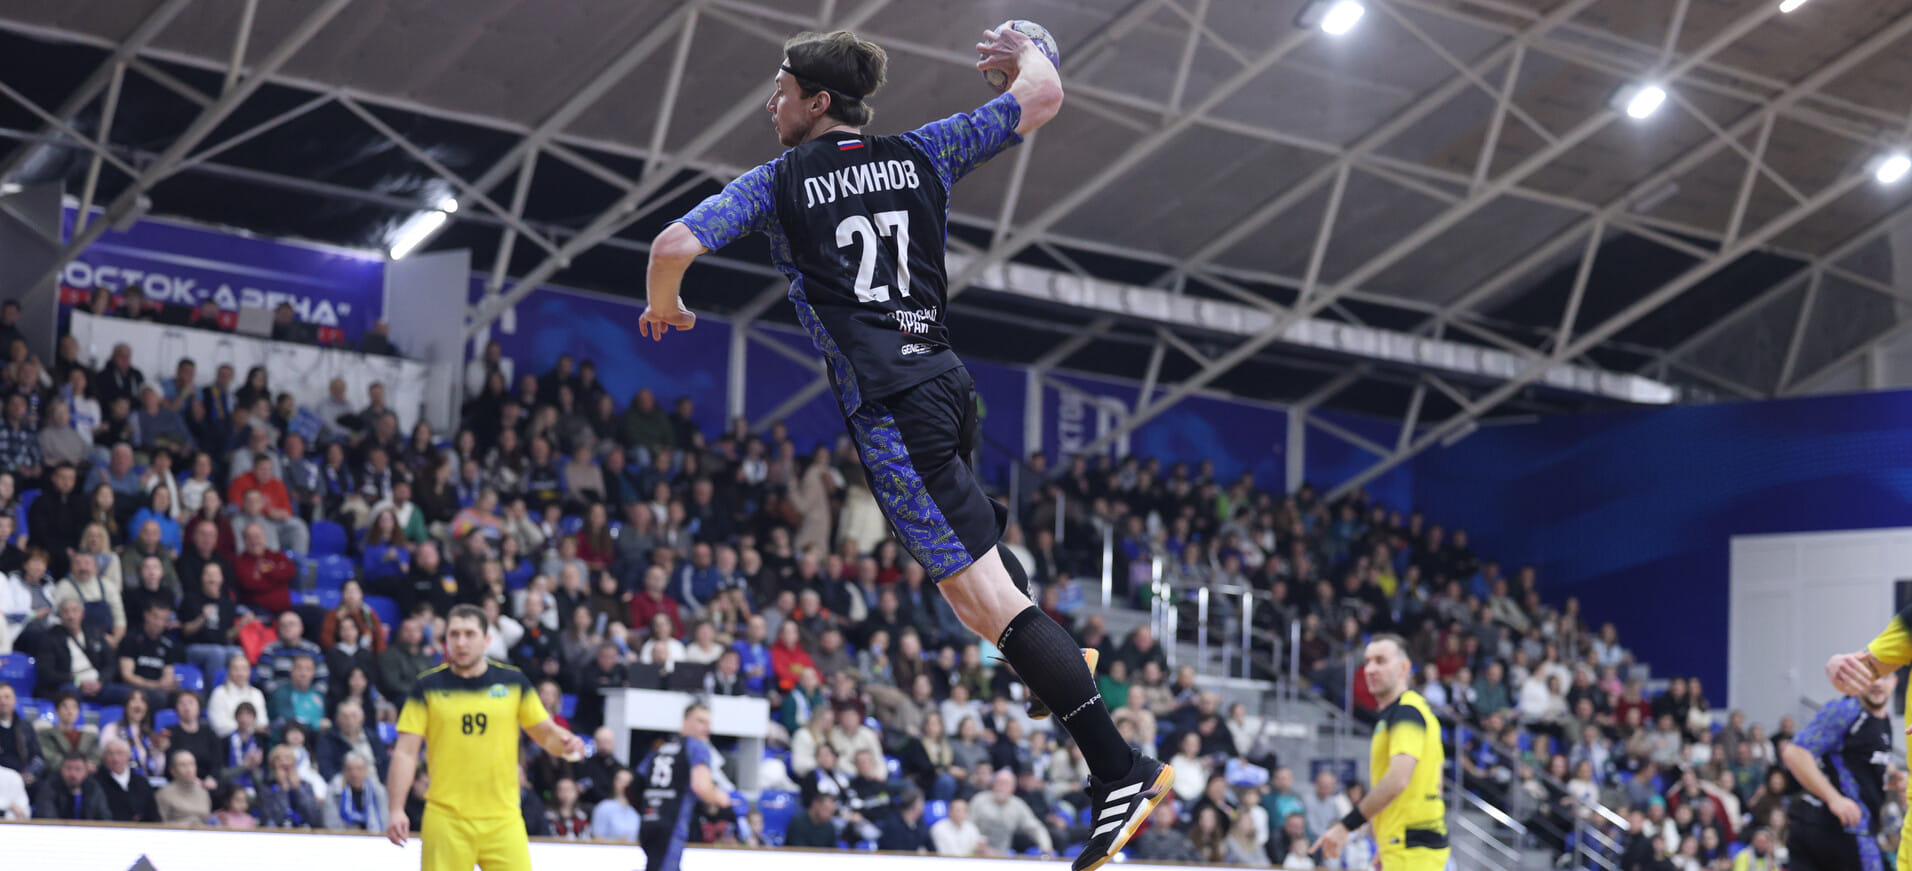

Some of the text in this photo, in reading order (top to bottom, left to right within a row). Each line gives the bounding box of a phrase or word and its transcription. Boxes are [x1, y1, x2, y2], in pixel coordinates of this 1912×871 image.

[804, 160, 920, 208] ЛУКИНОВ
[835, 210, 911, 302] 27
[462, 712, 487, 735] 89
